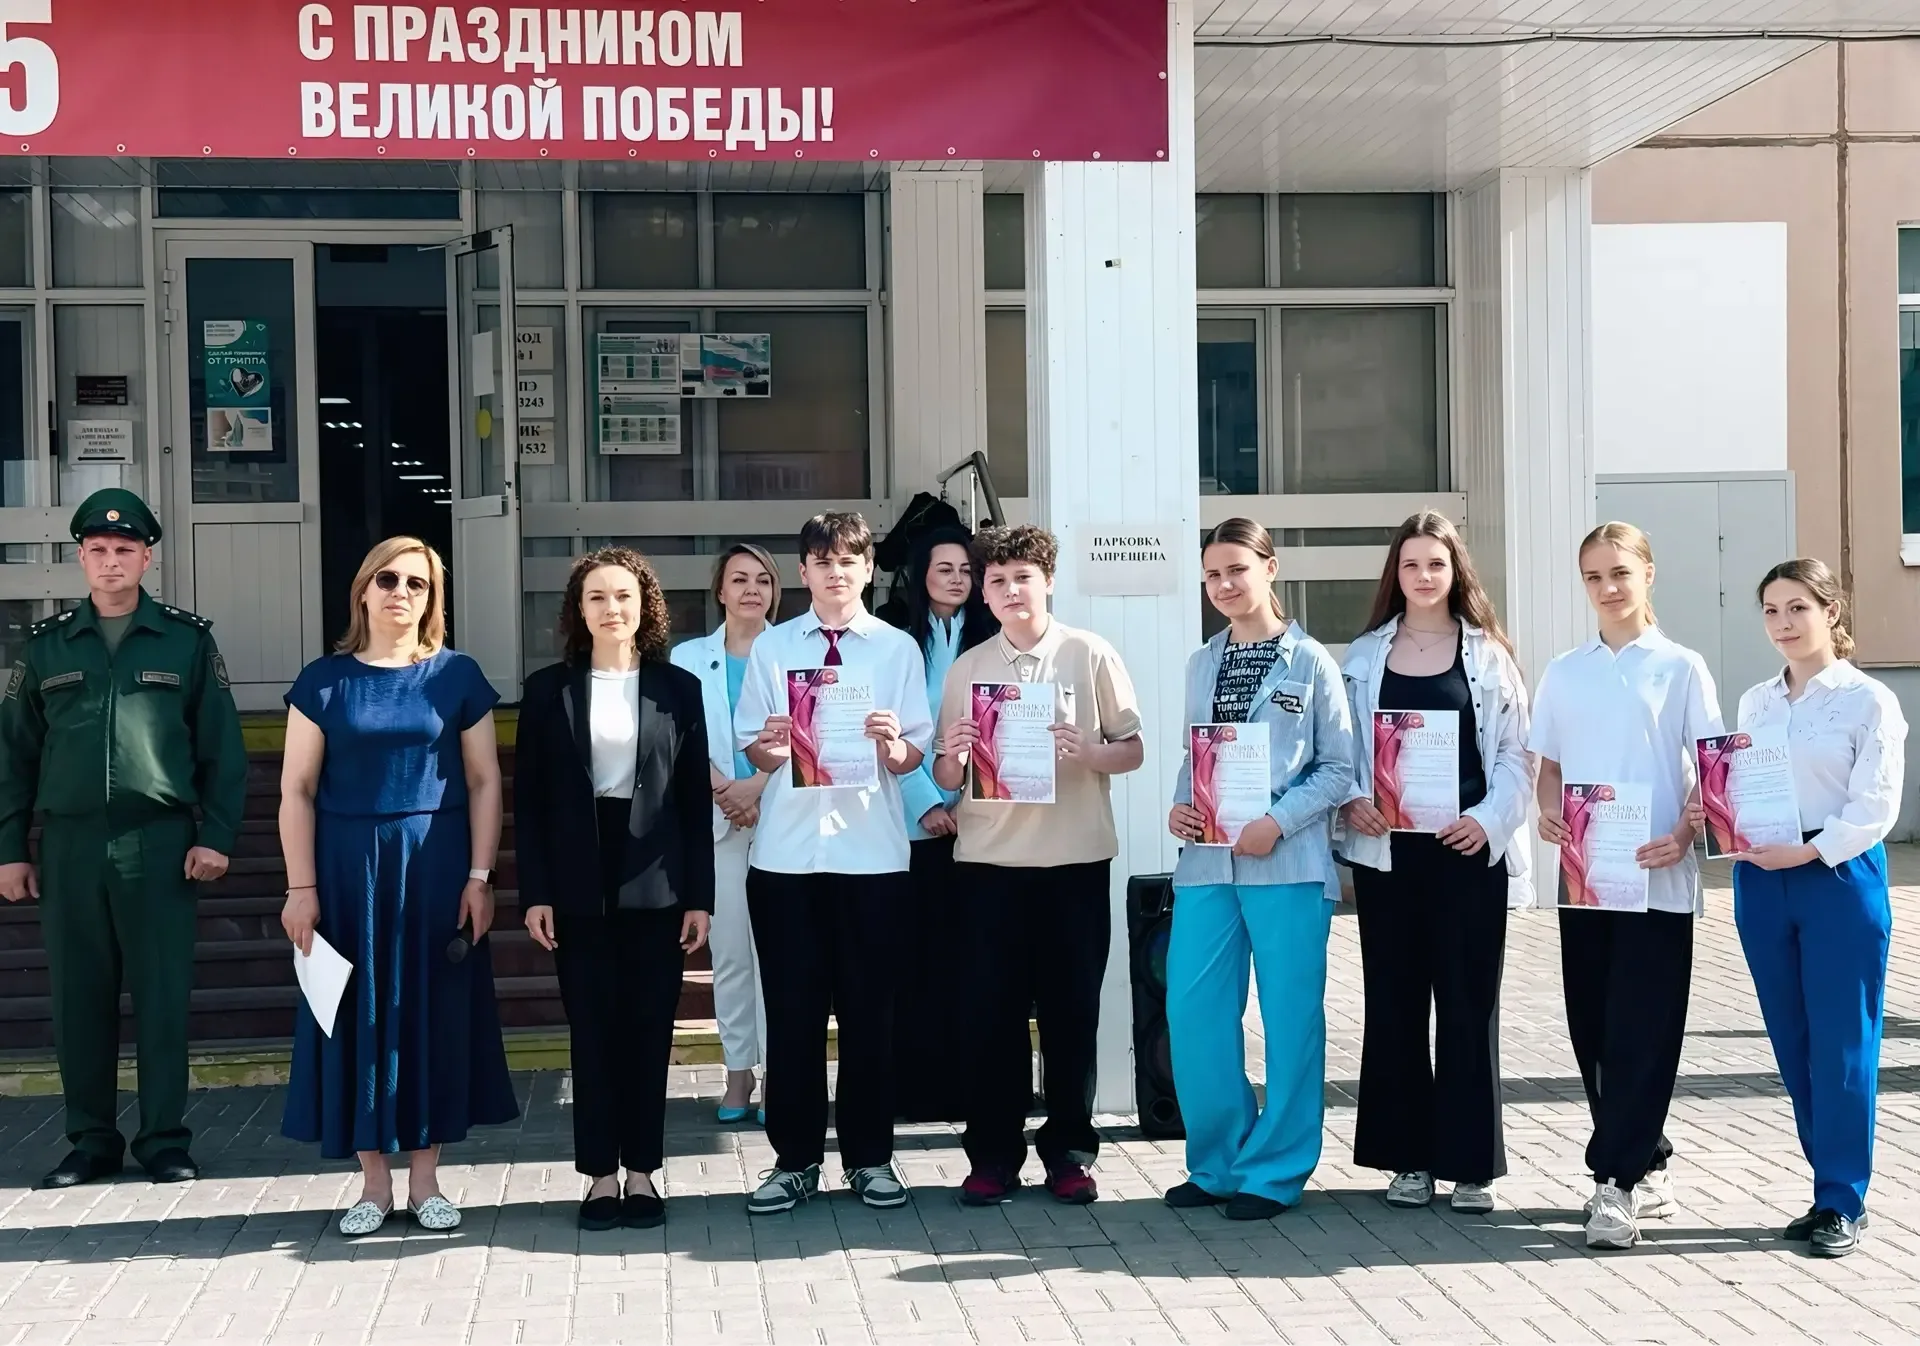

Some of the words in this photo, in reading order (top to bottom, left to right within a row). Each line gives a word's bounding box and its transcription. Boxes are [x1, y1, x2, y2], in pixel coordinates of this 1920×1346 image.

[299, 4, 333, 61] С
[354, 6, 742, 74] ПРАЗДНИКОМ
[301, 78, 563, 140] ВЕЛИКОЙ
[583, 86, 833, 150] ПОБЕДЫ!
[207, 357, 222, 365] ОТ
[224, 357, 267, 365] ГРИППА
[1093, 537, 1161, 547] ПАРКОВКА
[1089, 551, 1167, 562] ЗАПРЕЩЕНА
[1233, 649, 1276, 661] TURQUOISE
